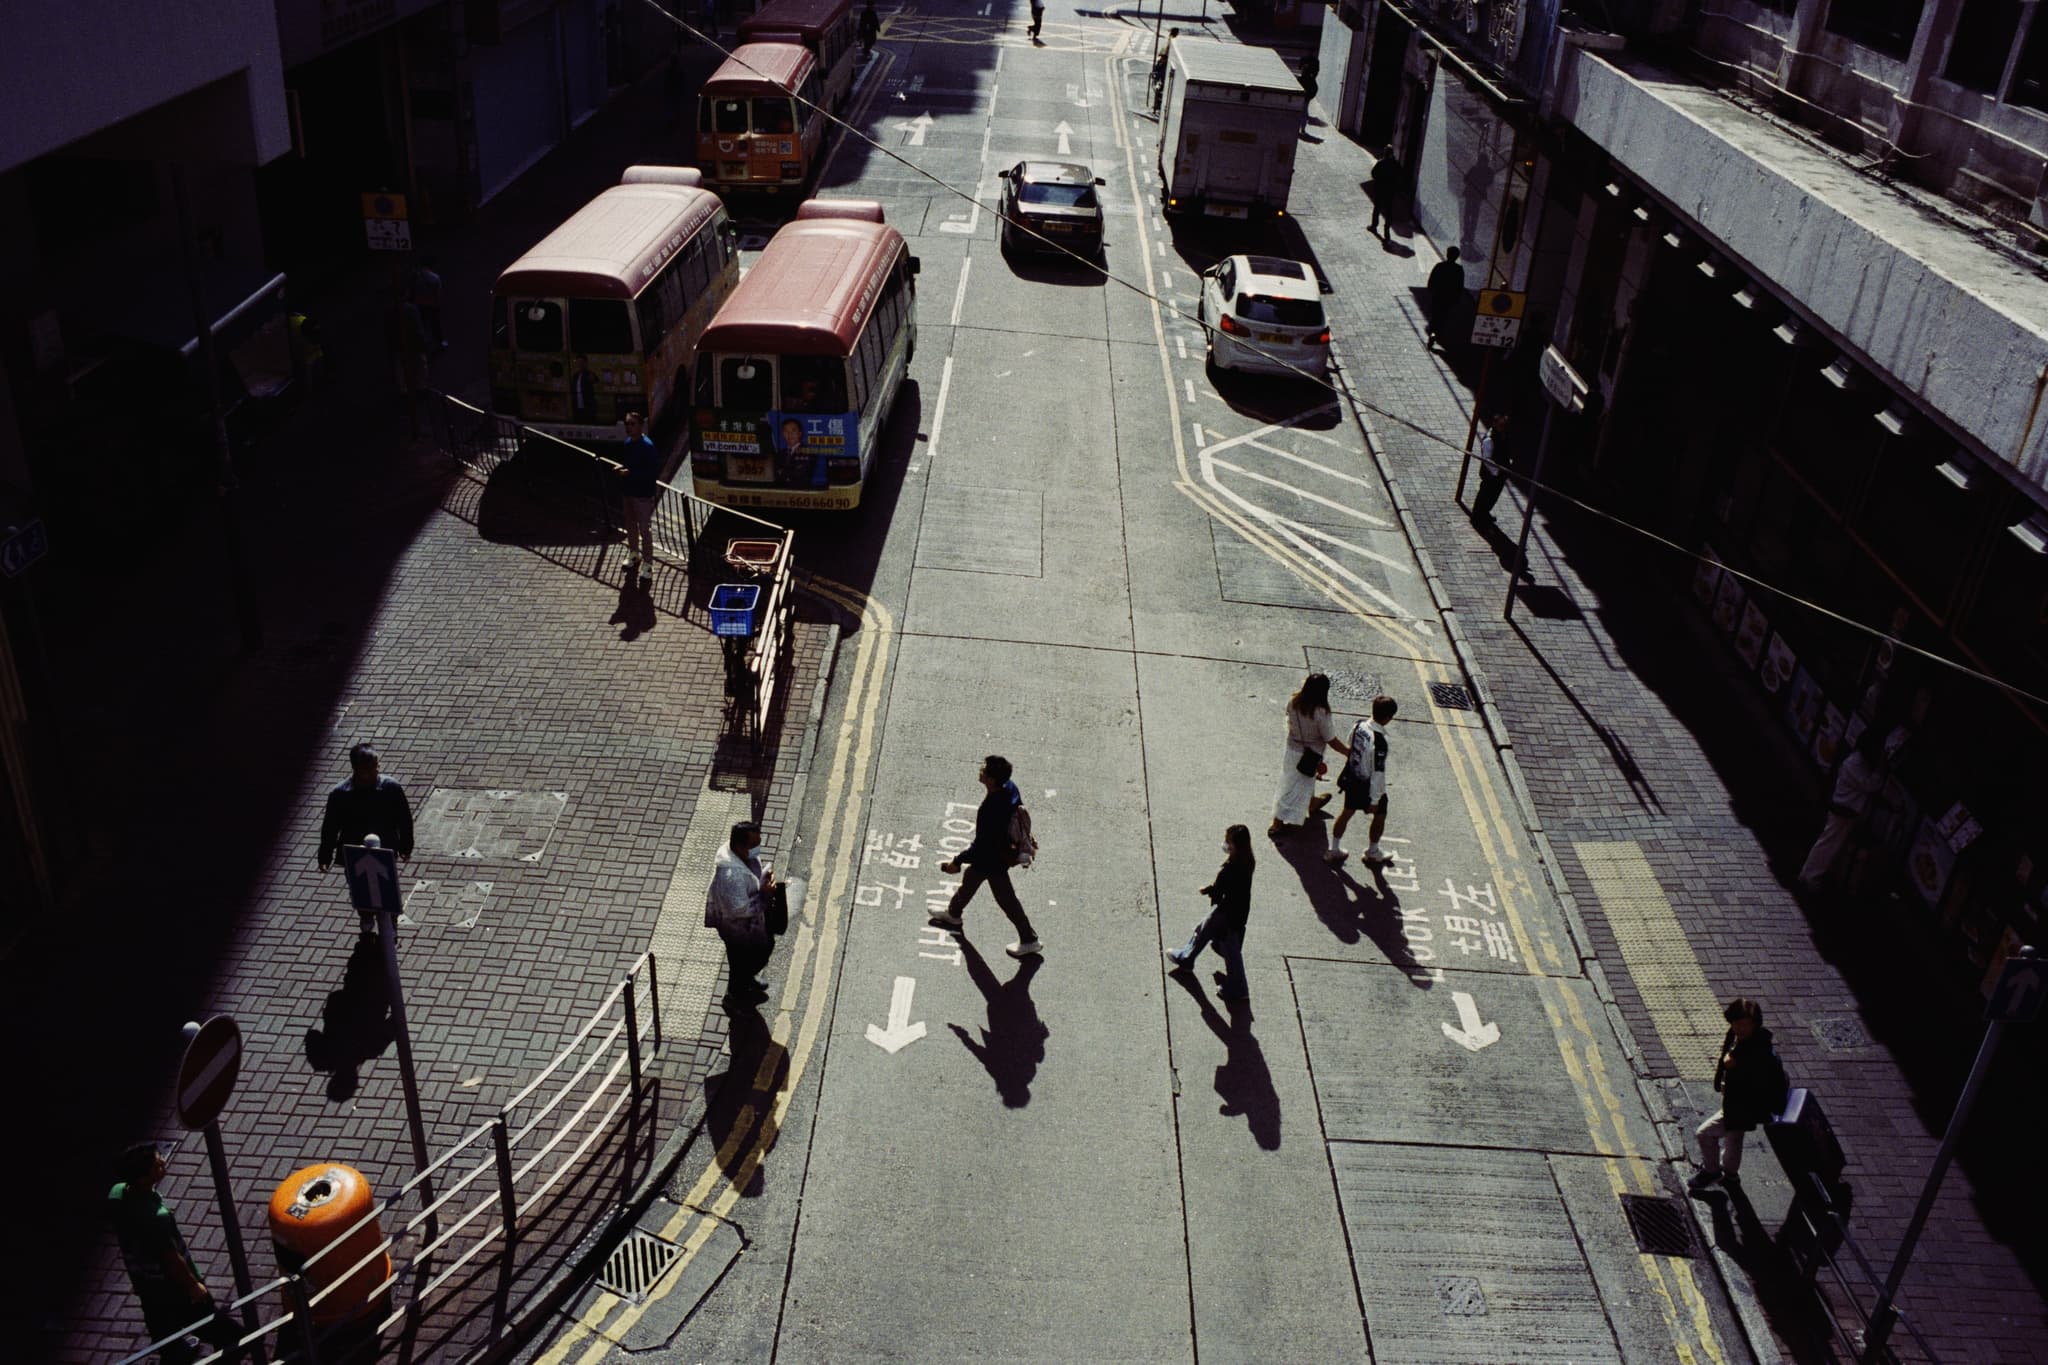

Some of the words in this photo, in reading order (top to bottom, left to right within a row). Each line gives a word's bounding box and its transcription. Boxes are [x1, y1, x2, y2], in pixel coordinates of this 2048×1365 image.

[395, 238, 409, 249] 12
[1504, 319, 1512, 330] 7
[1500, 335, 1514, 347] 12
[1437, 878, 1518, 963] 望左
